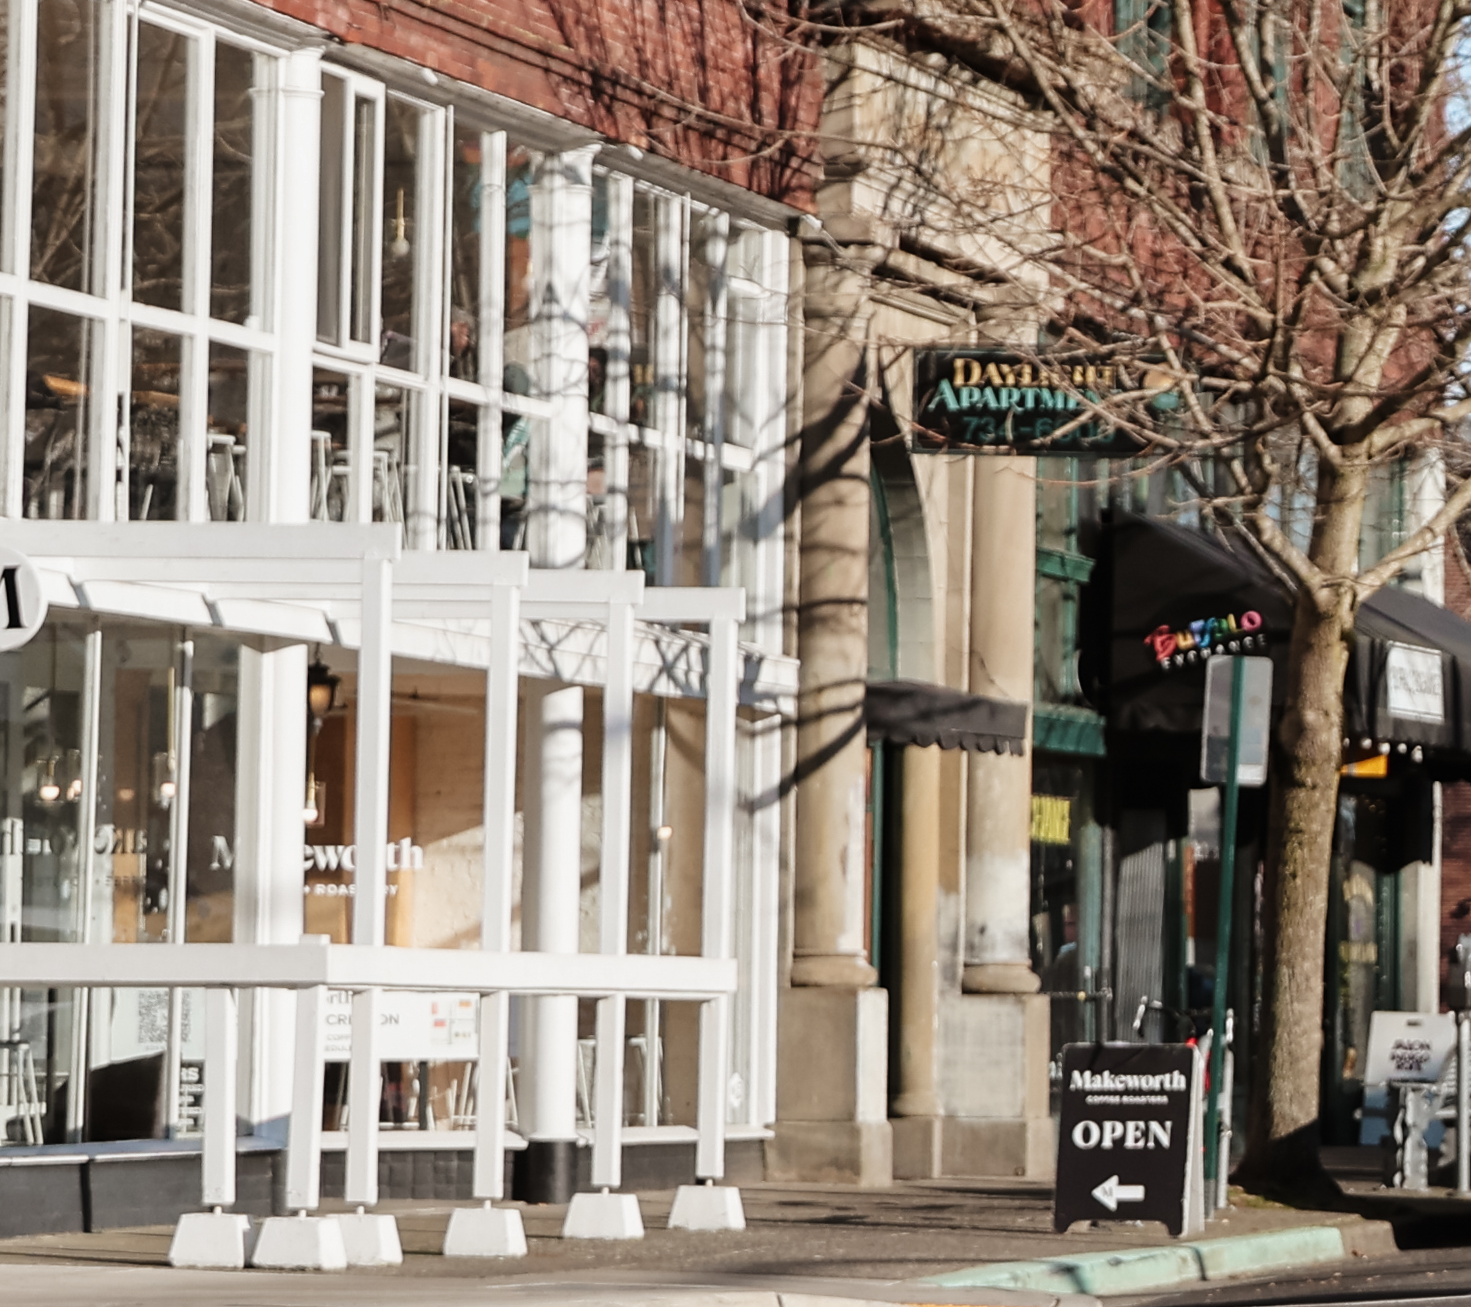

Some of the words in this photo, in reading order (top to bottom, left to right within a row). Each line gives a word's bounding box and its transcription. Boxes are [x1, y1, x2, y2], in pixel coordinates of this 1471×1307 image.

[1069, 1069, 1187, 1092] Makeworth
[1085, 1094, 1121, 1106] COFFEE
[1122, 1094, 1169, 1106] ROASTERS
[1071, 1119, 1173, 1150] OPEN
